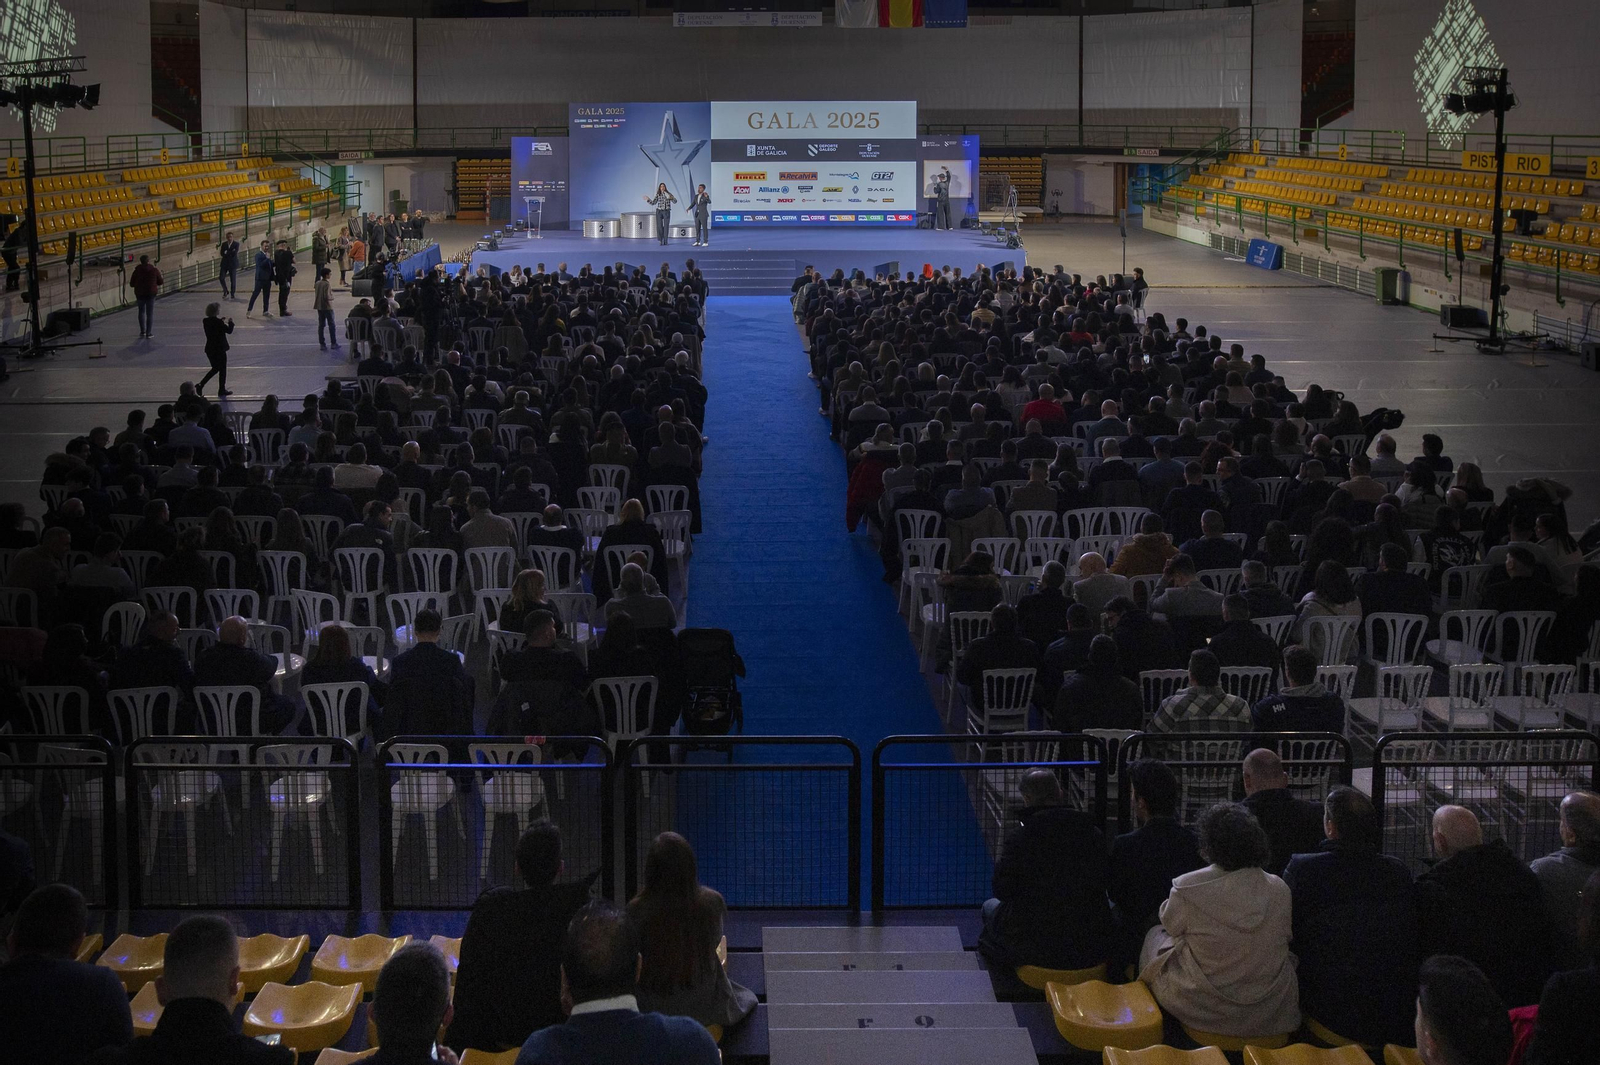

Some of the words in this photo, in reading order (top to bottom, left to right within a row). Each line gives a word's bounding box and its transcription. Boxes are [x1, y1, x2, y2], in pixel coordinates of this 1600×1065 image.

[577, 107, 604, 116] GALA
[747, 112, 819, 130] GALA
[827, 112, 880, 129] 2025
[162, 151, 167, 162] 5
[1340, 147, 1345, 158] 2
[10, 161, 16, 174] 4
[1470, 154, 1498, 168] PIST
[1516, 156, 1541, 171] RIO
[1590, 160, 1598, 176] 3
[599, 224, 604, 233] 2
[638, 222, 643, 230] 1
[1272, 702, 1286, 713] HH
